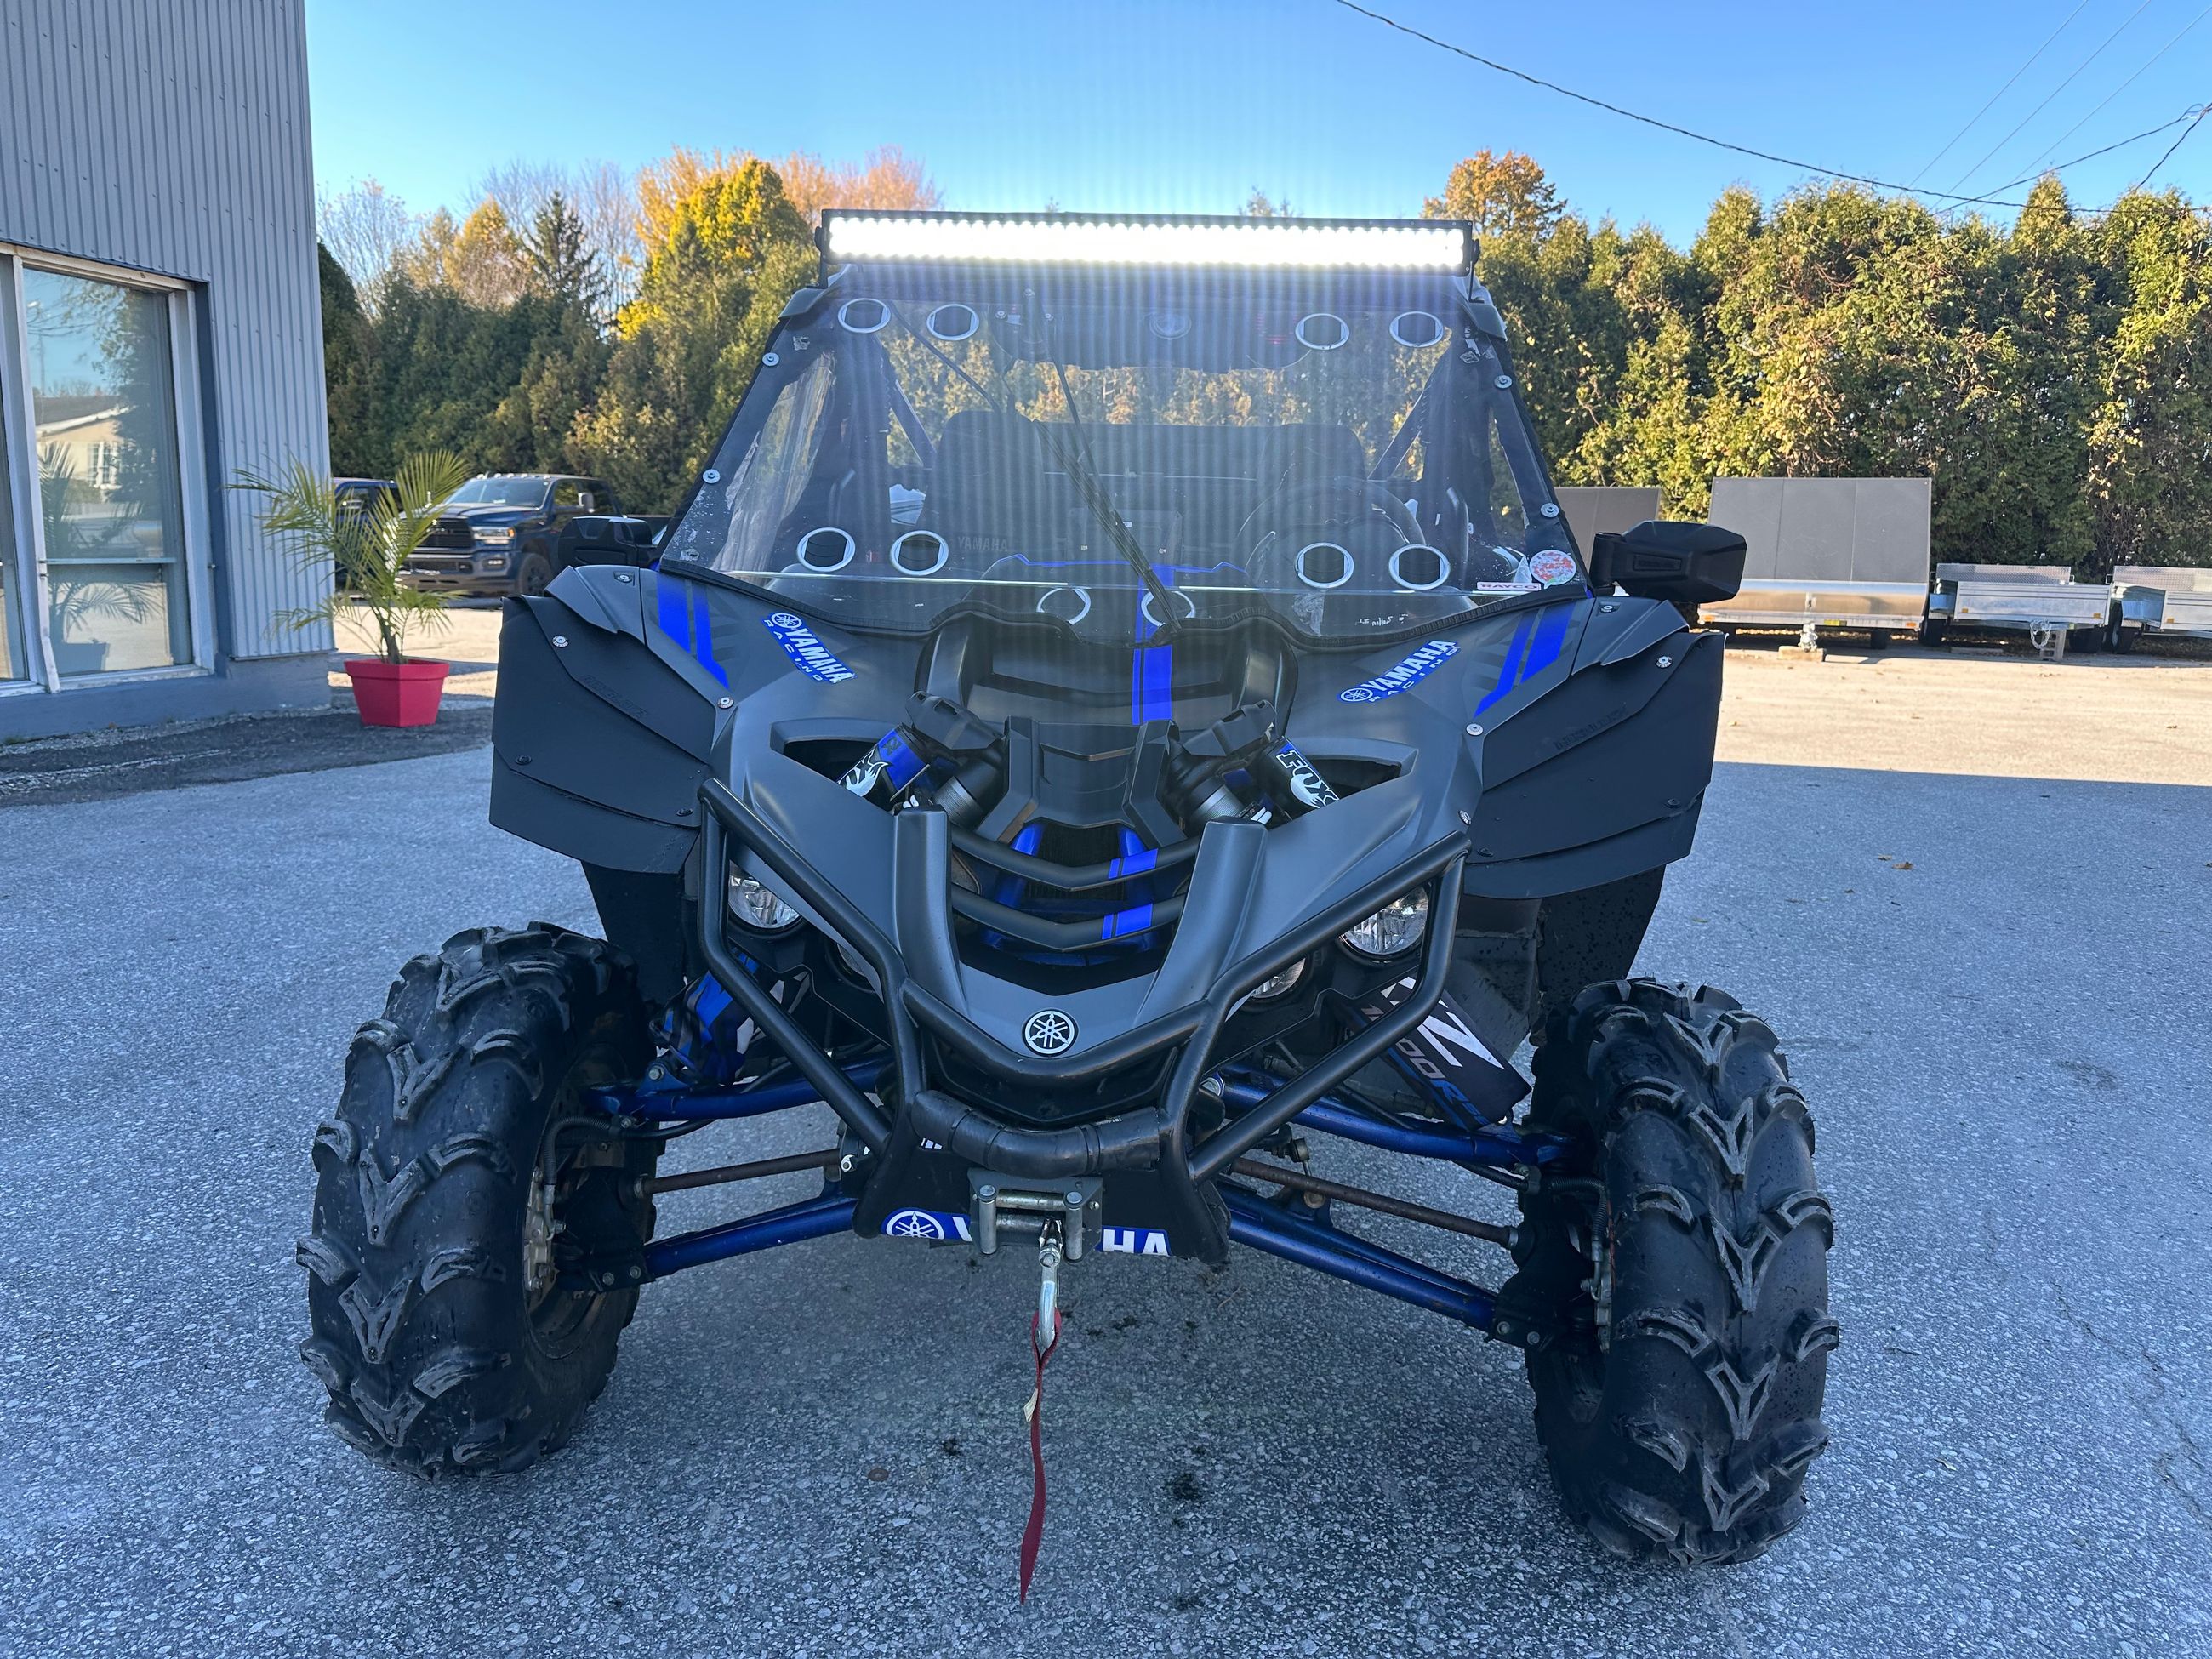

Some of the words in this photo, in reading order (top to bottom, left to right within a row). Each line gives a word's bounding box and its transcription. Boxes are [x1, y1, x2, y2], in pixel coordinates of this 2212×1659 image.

[957, 536, 1008, 552] YAMAHA
[763, 619, 824, 681] RACING
[785, 627, 855, 684] YAMAHA
[1360, 640, 1457, 692] YAMAHA
[1368, 647, 1462, 703] RACING
[837, 748, 890, 797] OX
[1276, 750, 1340, 809] FOX
